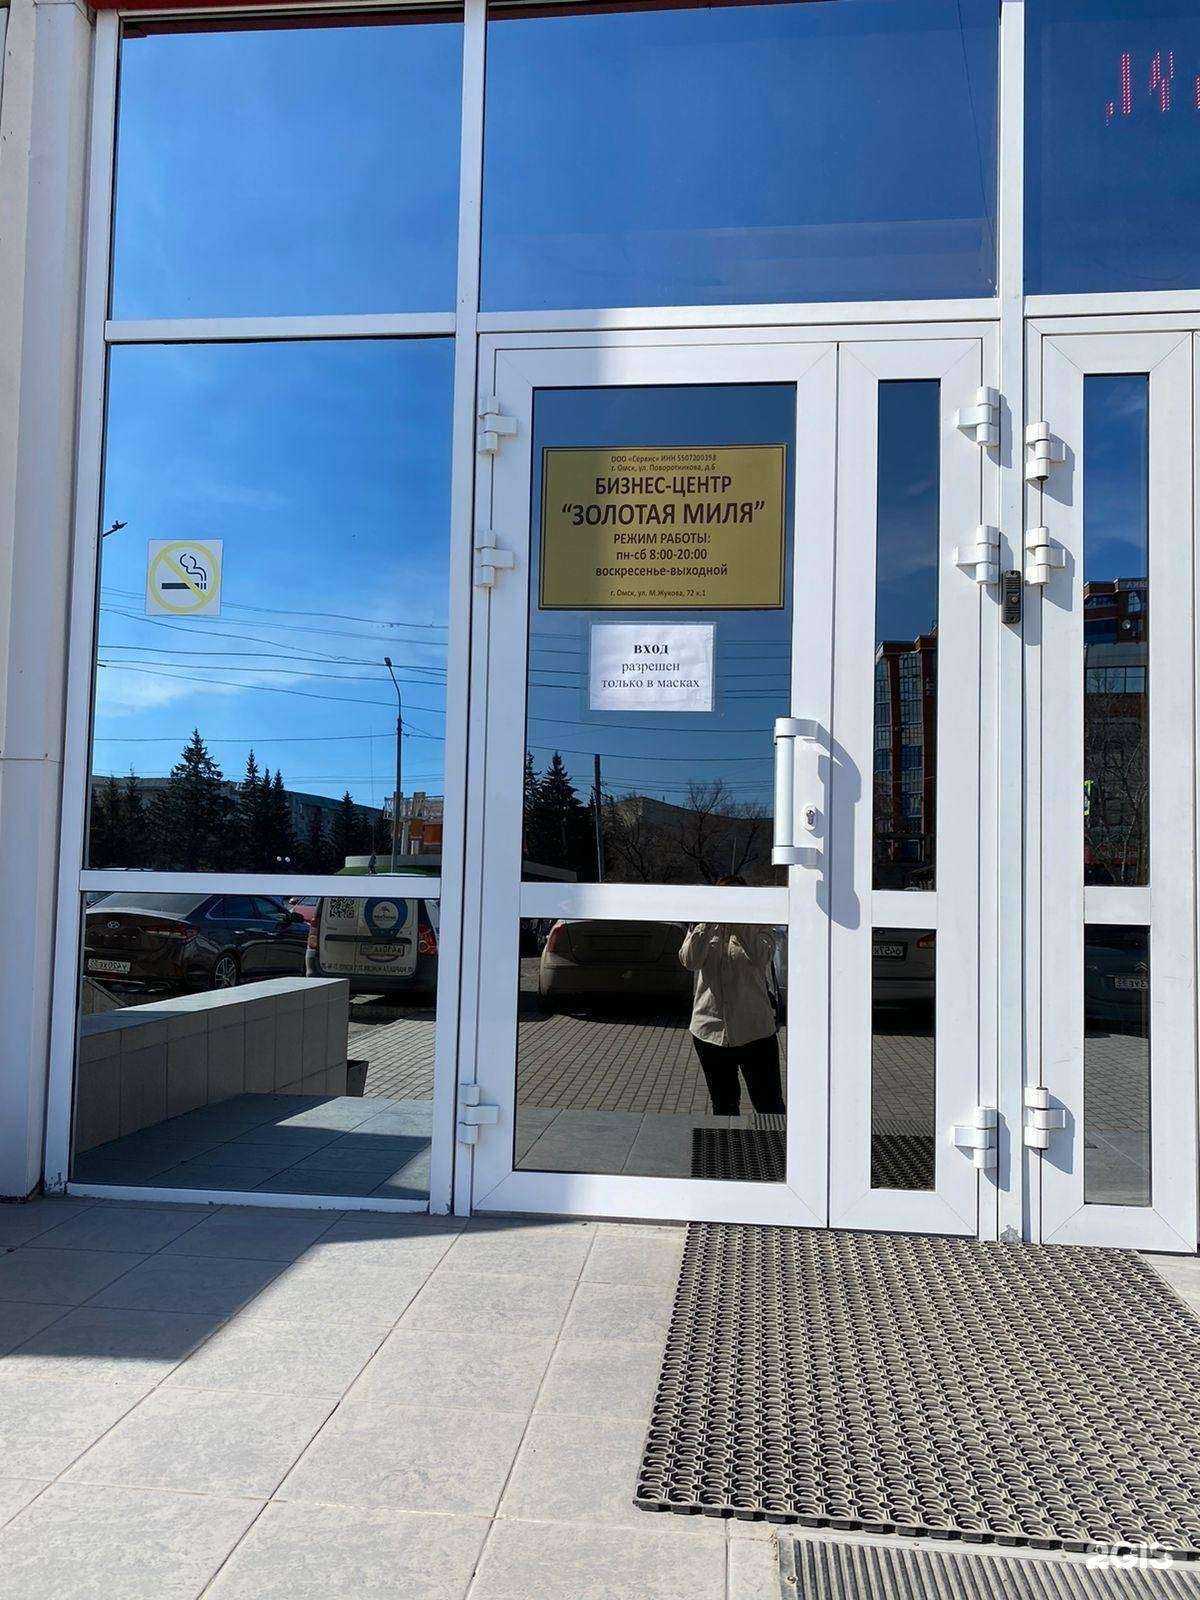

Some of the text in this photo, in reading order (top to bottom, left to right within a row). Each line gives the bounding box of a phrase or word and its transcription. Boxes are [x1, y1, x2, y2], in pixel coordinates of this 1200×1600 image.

[611, 455, 627, 463] ООО
[595, 475, 733, 498] БИЗНЕС-ЦЕНТР
[613, 532, 711, 544] РЕЖИМ РАБОТЫ:
[616, 548, 708, 560] пн-сб 8:00-20:00
[595, 563, 729, 578] воскресенье-выходной
[686, 589, 695, 597] 72
[621, 662, 680, 675] разрешен
[601, 679, 700, 688] только в масках
